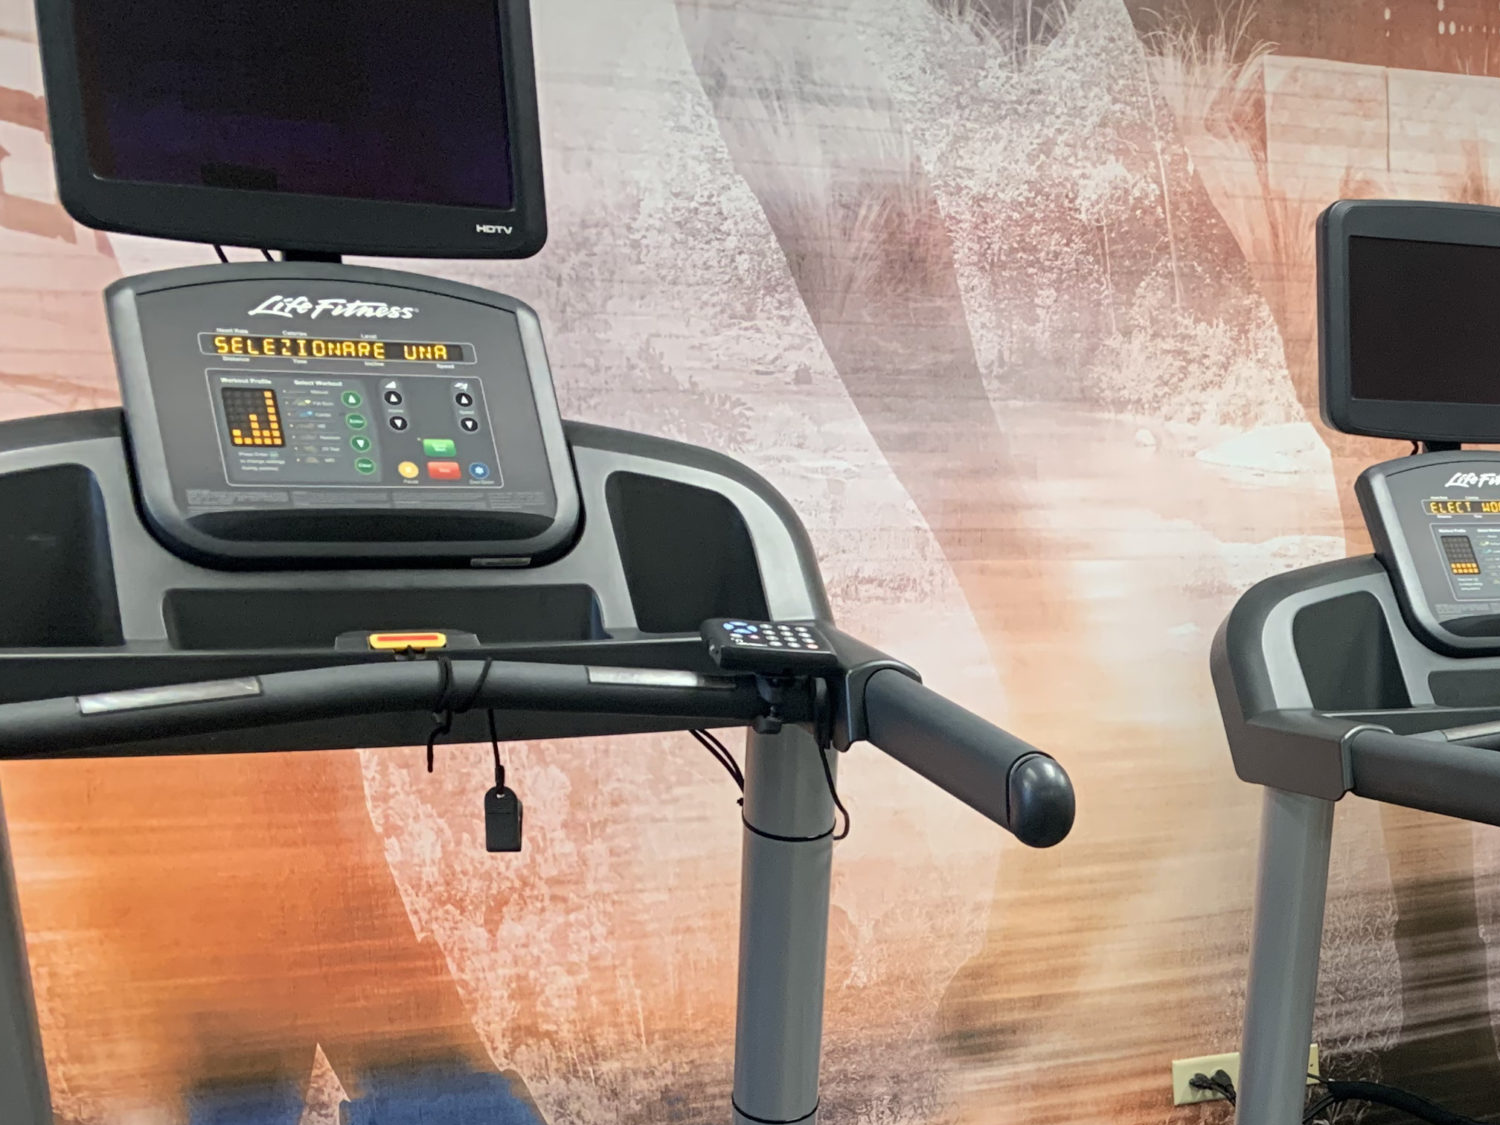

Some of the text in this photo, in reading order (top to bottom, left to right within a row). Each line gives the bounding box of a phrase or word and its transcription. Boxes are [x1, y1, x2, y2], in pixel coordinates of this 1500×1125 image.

[475, 223, 513, 235] HDTV
[248, 294, 414, 319] Life Fitness
[213, 336, 448, 360] SELEZIONARE UNA
[1444, 472, 1477, 488] Life
[1429, 501, 1472, 514] ELECT
